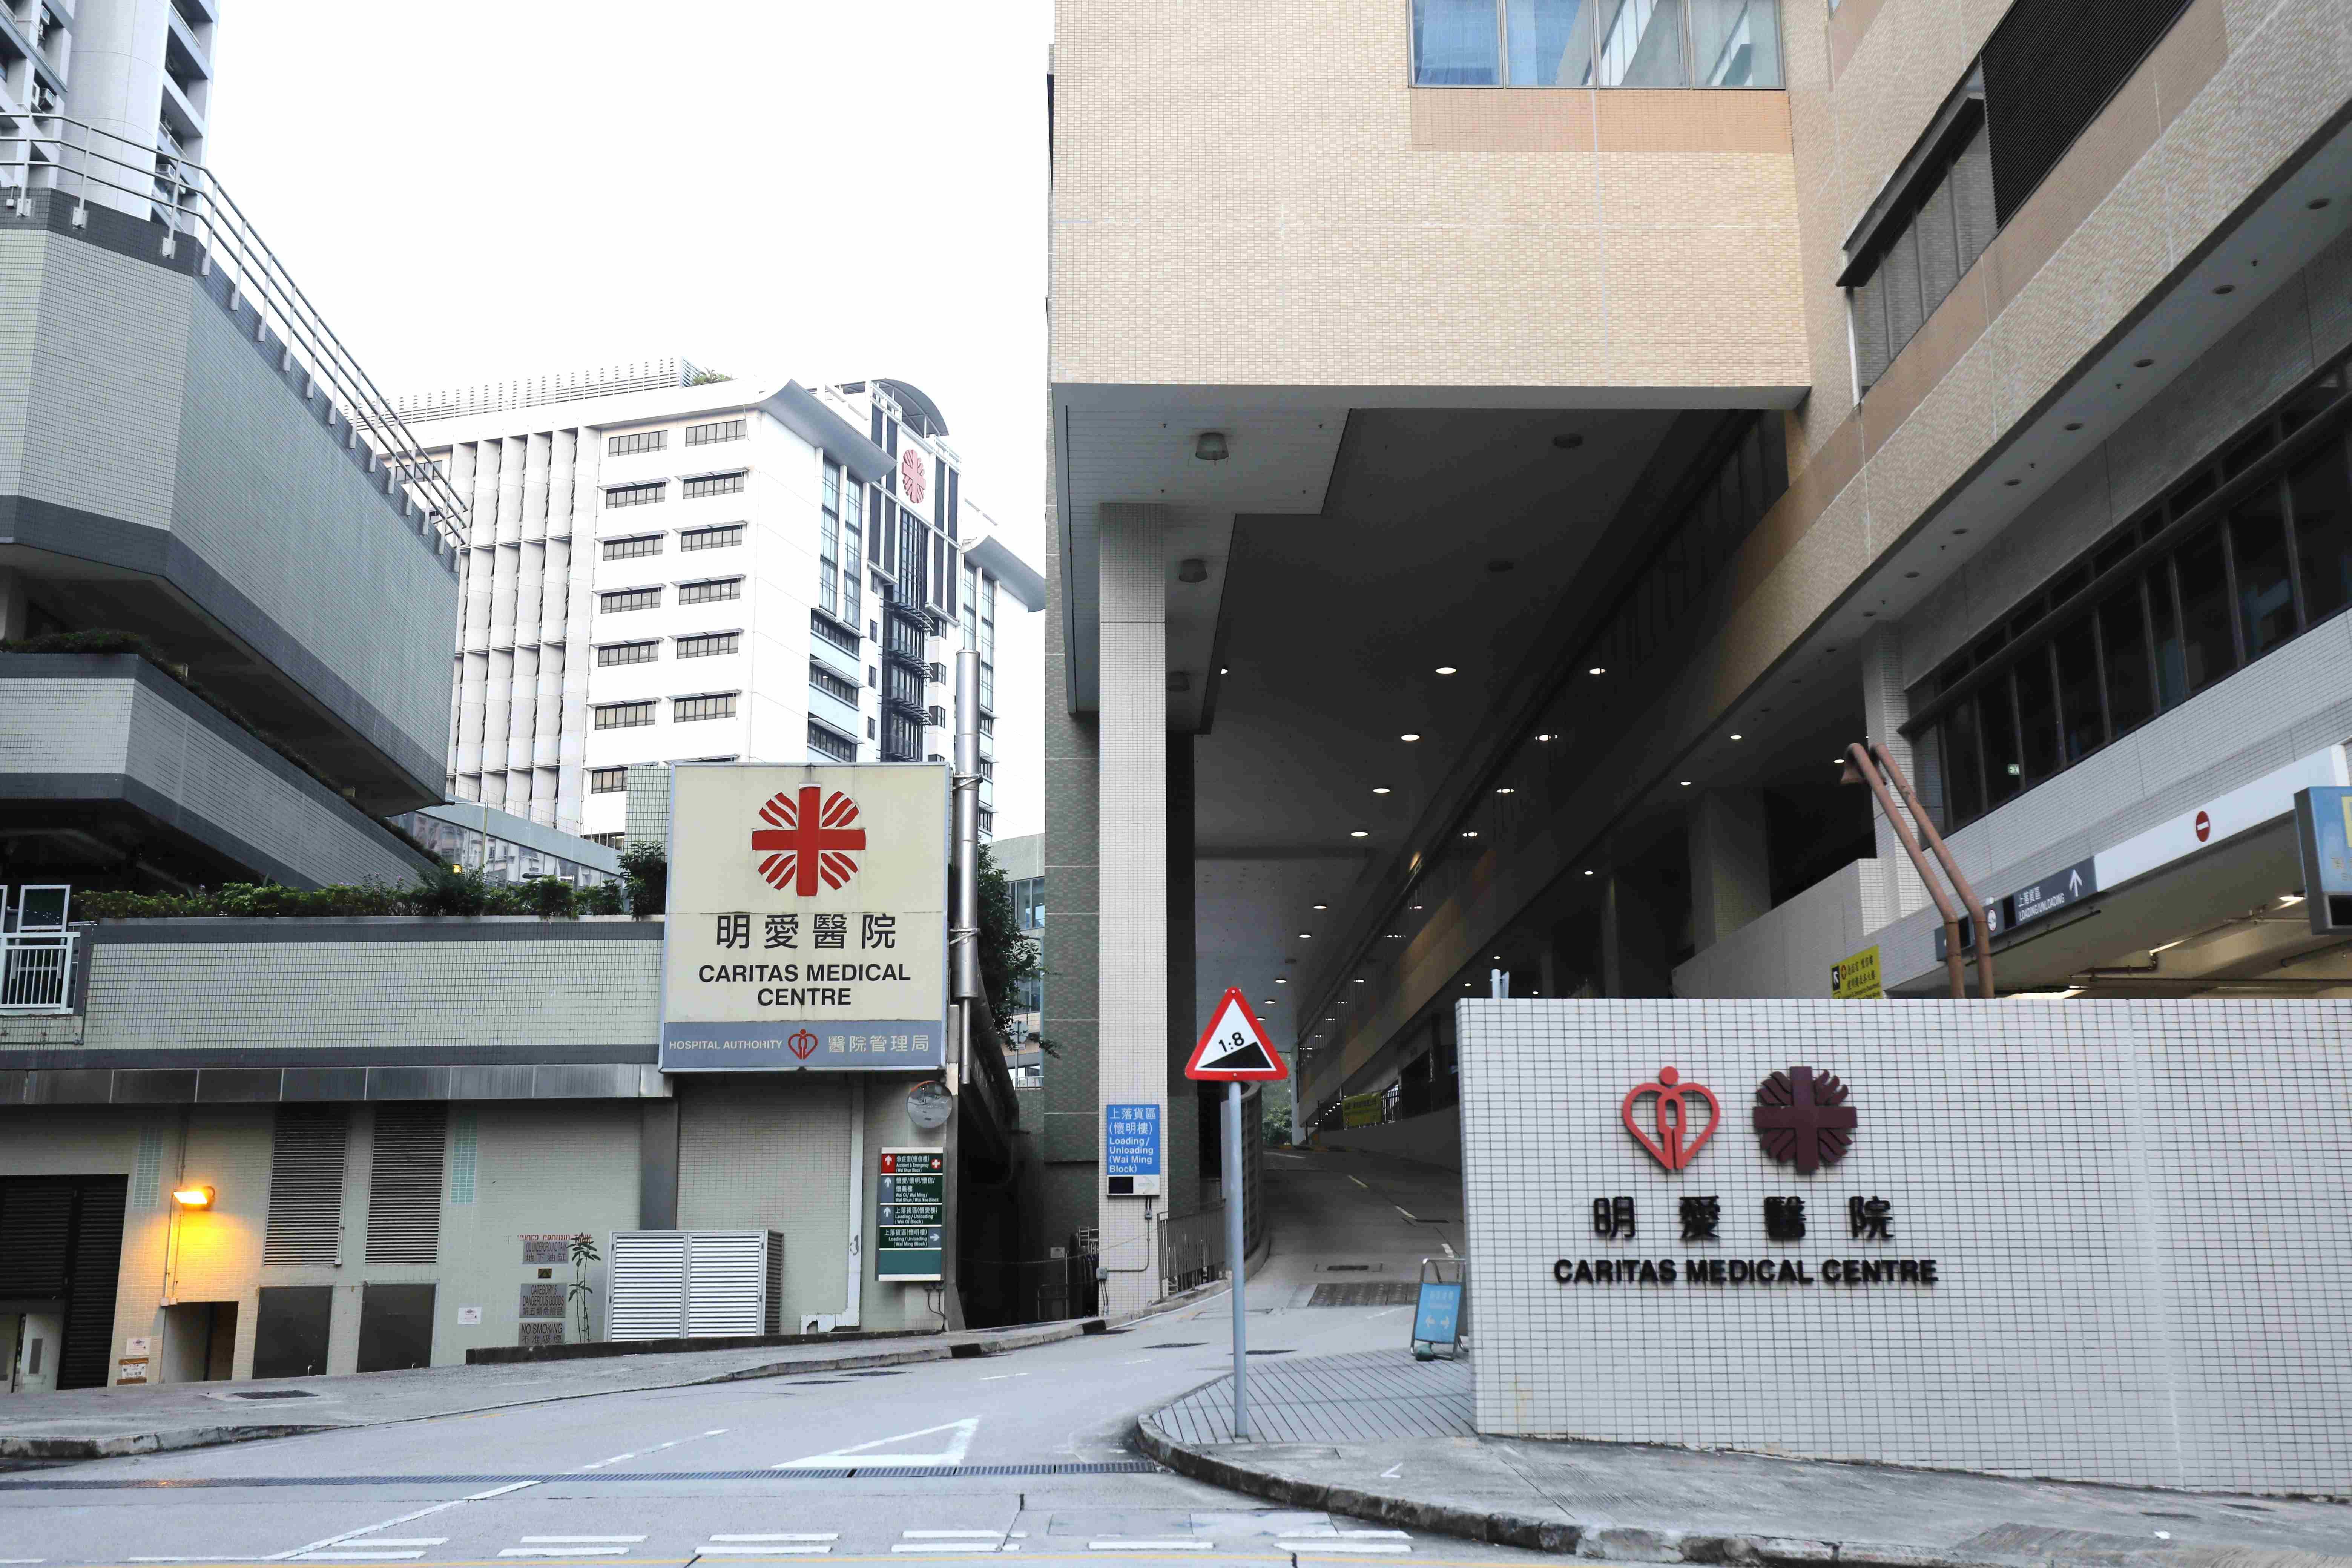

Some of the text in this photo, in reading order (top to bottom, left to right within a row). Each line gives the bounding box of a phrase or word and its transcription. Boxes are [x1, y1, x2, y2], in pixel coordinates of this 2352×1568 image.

[717, 914, 896, 949] 明愛醫院
[699, 964, 911, 982] CARITAS MEDICAL
[758, 988, 851, 1006] CENTRE
[669, 1040, 782, 1050] HOSPITAL AUTHORITY
[828, 1034, 928, 1053] 醫院管理局
[1218, 1032, 1244, 1052] 1:8
[1110, 1108, 1156, 1120] 上落貨區
[1109, 1122, 1152, 1135] (懷明樓)
[1110, 1137, 1144, 1146] Loading
[1110, 1146, 1154, 1155] Unloading
[1109, 1155, 1152, 1164] (Wai Ming
[1110, 1164, 1137, 1173] Block)
[1593, 1195, 1893, 1239] 明愛醫院
[526, 1253, 566, 1262] 地下油缸
[1553, 1259, 1938, 1283] CARITAS MEDICAL CENTRE
[531, 1285, 554, 1295] CATEGORY
[523, 1295, 564, 1306] DANGEROUS GOODS
[522, 1323, 563, 1334] NO SMOKING
